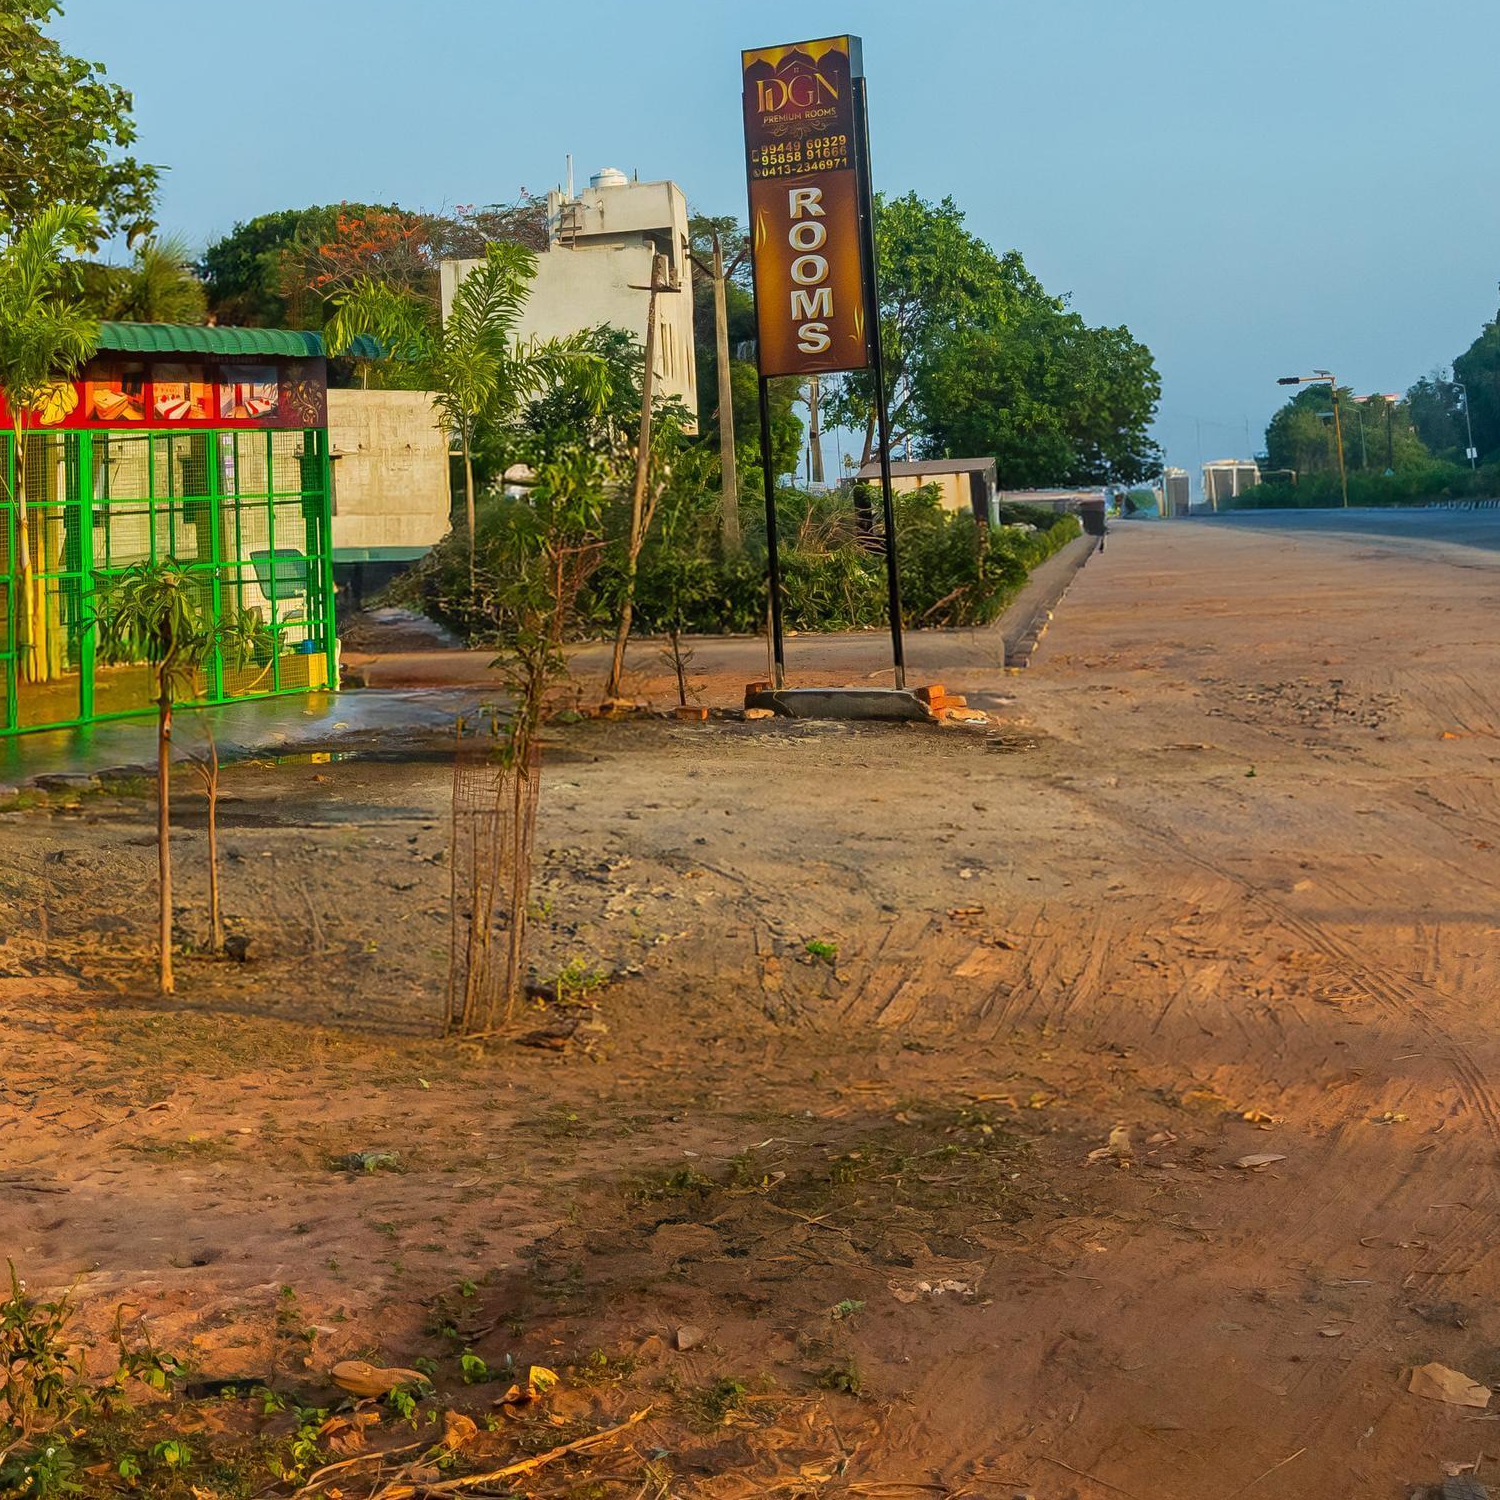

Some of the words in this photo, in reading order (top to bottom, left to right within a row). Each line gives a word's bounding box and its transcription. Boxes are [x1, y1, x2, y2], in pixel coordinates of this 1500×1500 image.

[763, 113, 802, 124] PREMIUM
[804, 107, 837, 119] ROOMS
[761, 142, 801, 155] 99449
[806, 135, 847, 149] 60329
[761, 152, 801, 165] 95858
[806, 145, 847, 159] 91666
[762, 158, 848, 177] 0413-2346971
[788, 187, 834, 354] ROOMS
